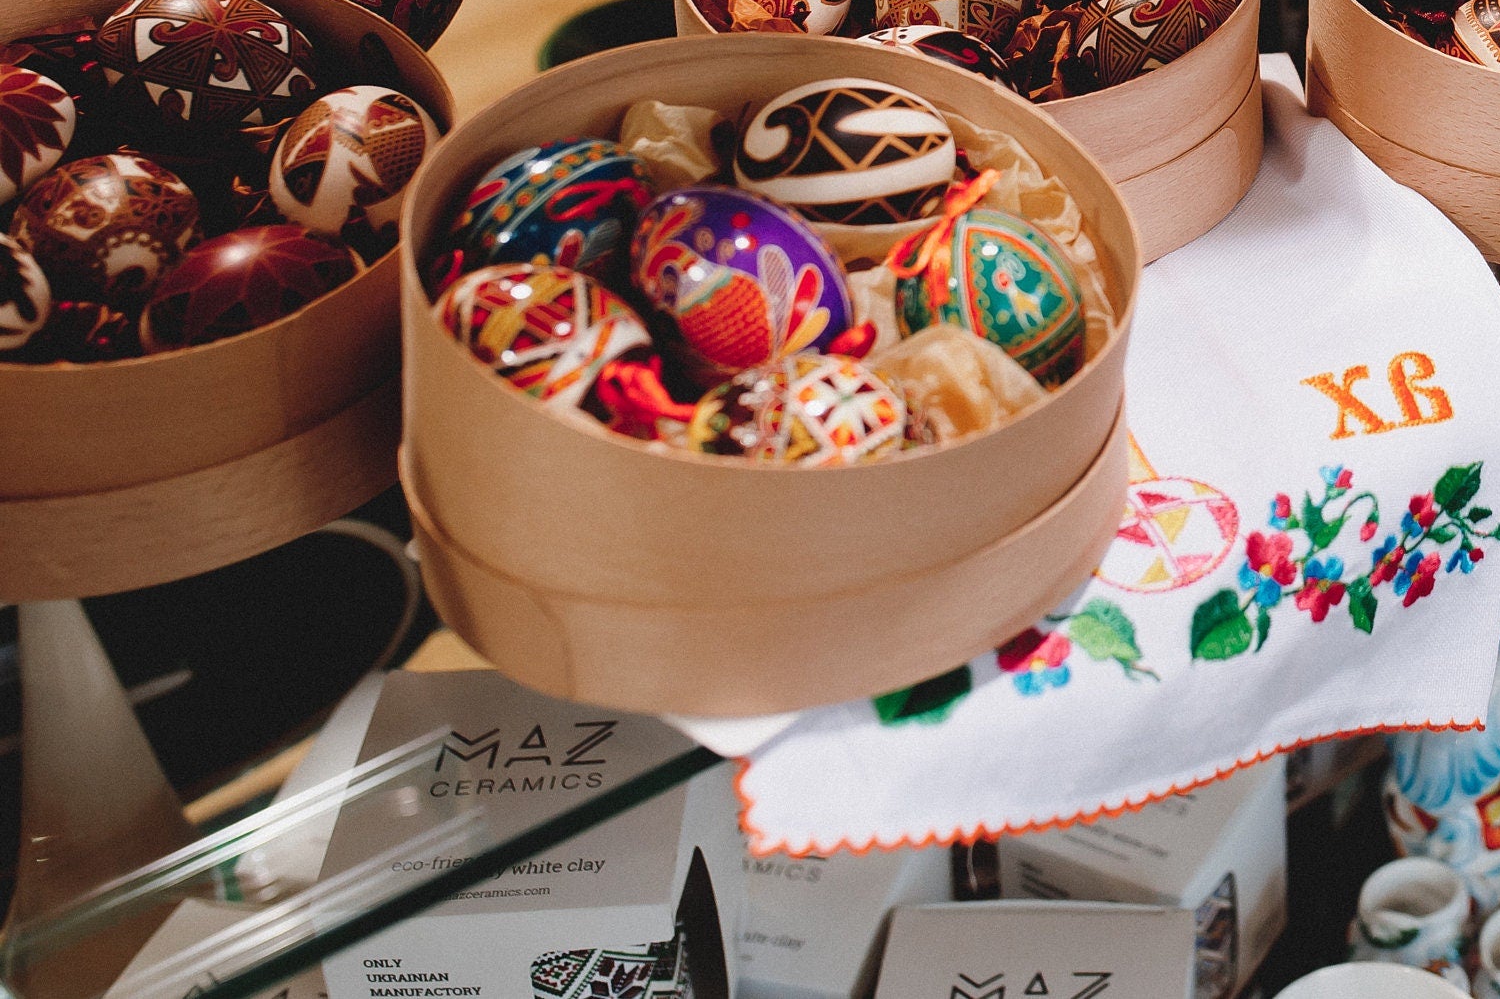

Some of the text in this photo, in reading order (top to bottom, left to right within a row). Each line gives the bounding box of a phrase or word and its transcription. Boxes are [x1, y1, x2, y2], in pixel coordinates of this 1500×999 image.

[434, 720, 619, 772] MAZ
[429, 772, 603, 798] CERAMICS
[511, 860, 563, 876] white
[567, 857, 606, 875] clay
[363, 958, 402, 969] ONLY
[366, 972, 450, 983] UKRAINIAN
[369, 986, 483, 997] MANUFACTORY
